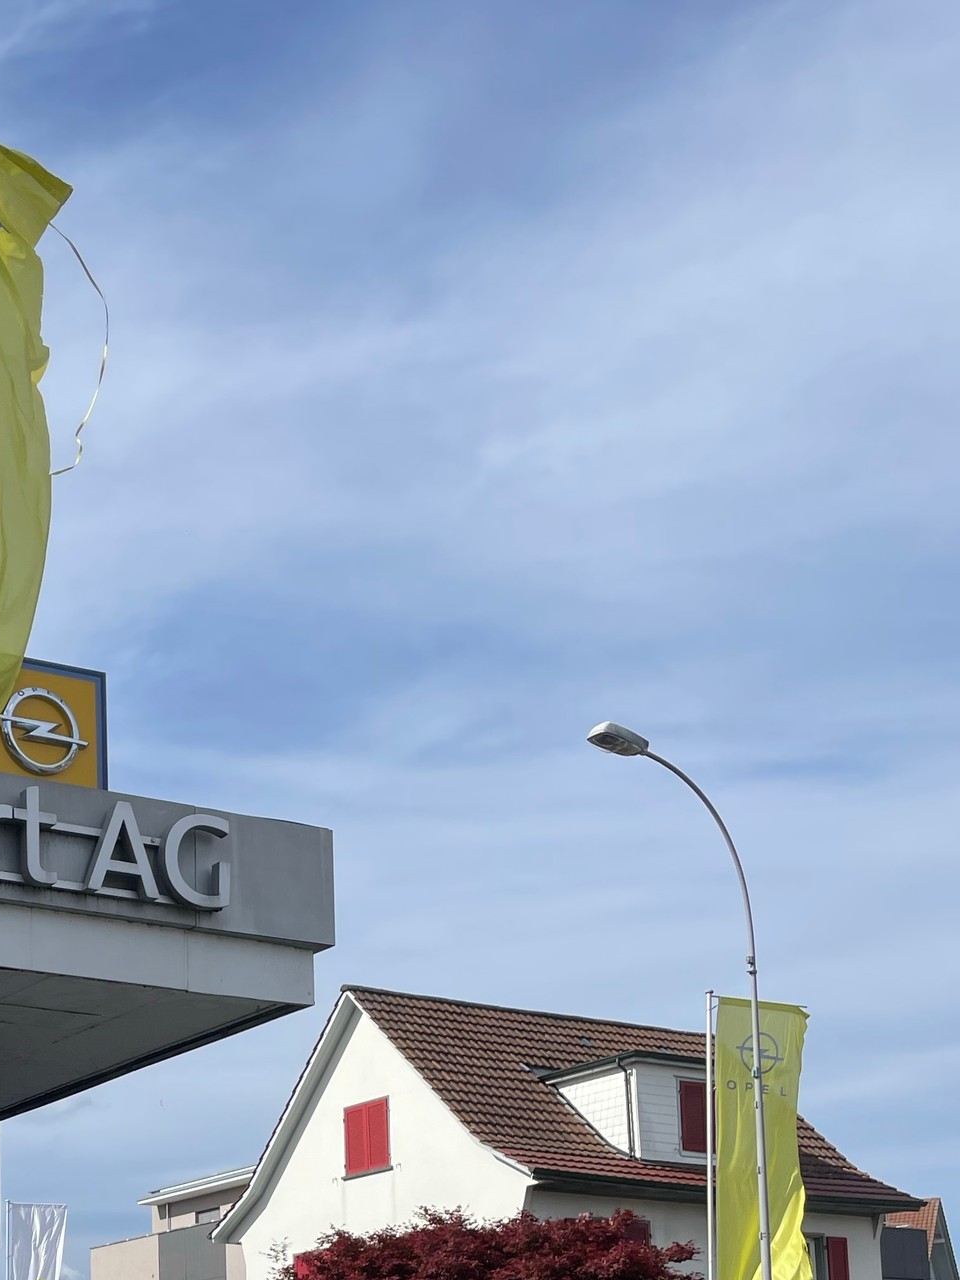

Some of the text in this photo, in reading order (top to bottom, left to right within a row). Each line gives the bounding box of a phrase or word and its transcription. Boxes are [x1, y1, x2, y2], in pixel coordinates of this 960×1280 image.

[17, 686, 65, 704] OPEL
[84, 801, 230, 911] AG
[726, 1080, 787, 1097] OPEL
